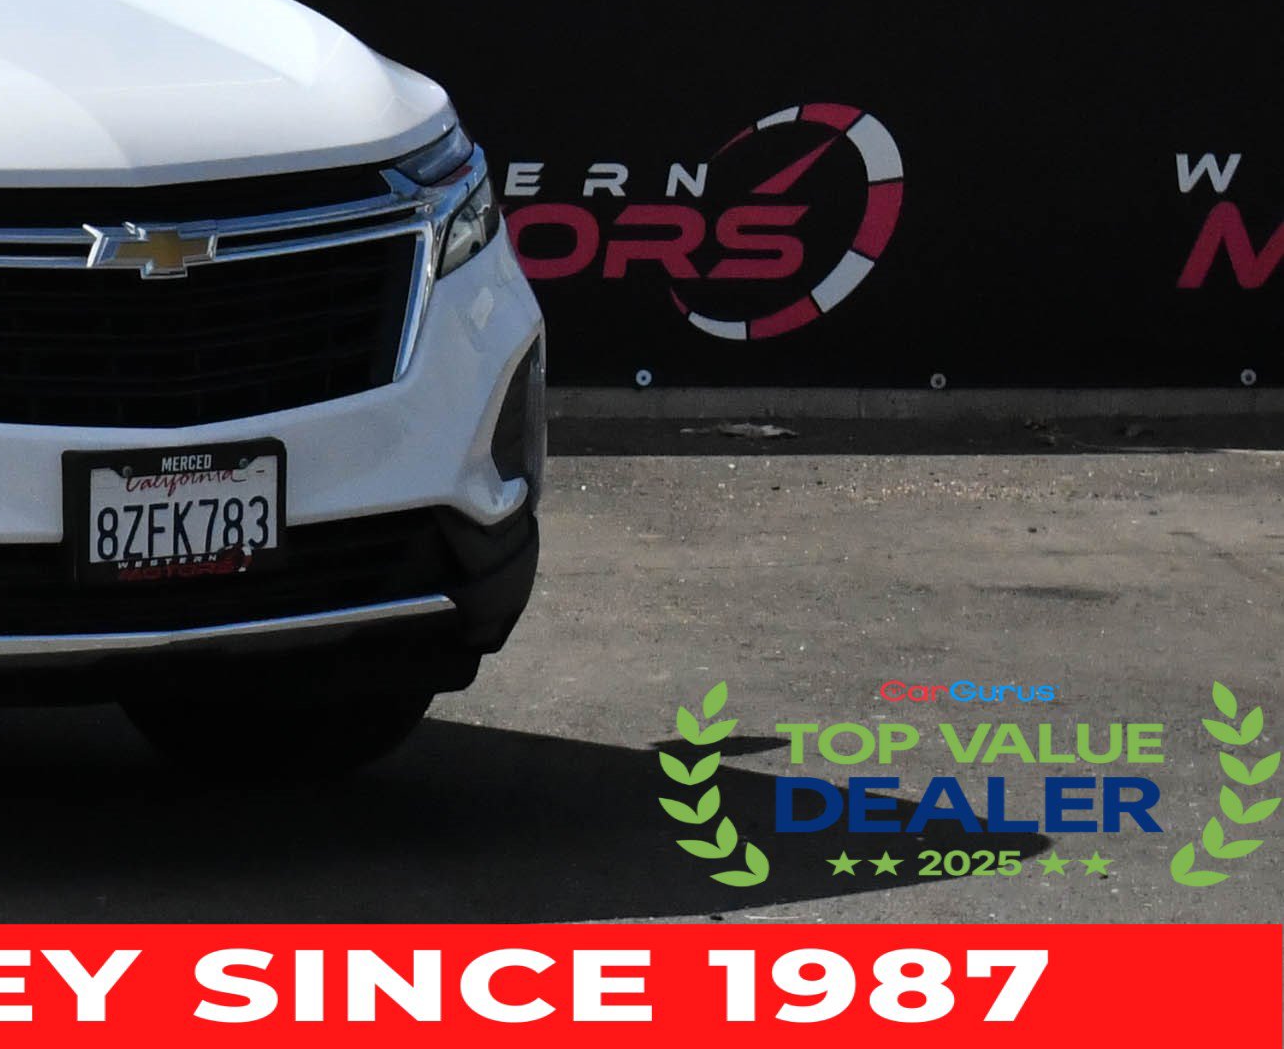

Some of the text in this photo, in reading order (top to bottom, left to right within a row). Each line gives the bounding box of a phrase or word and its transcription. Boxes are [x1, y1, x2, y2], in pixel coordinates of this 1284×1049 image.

[161, 454, 212, 472] MERCED
[97, 495, 269, 560] 8ZFK783
[118, 554, 217, 569] WESTERN
